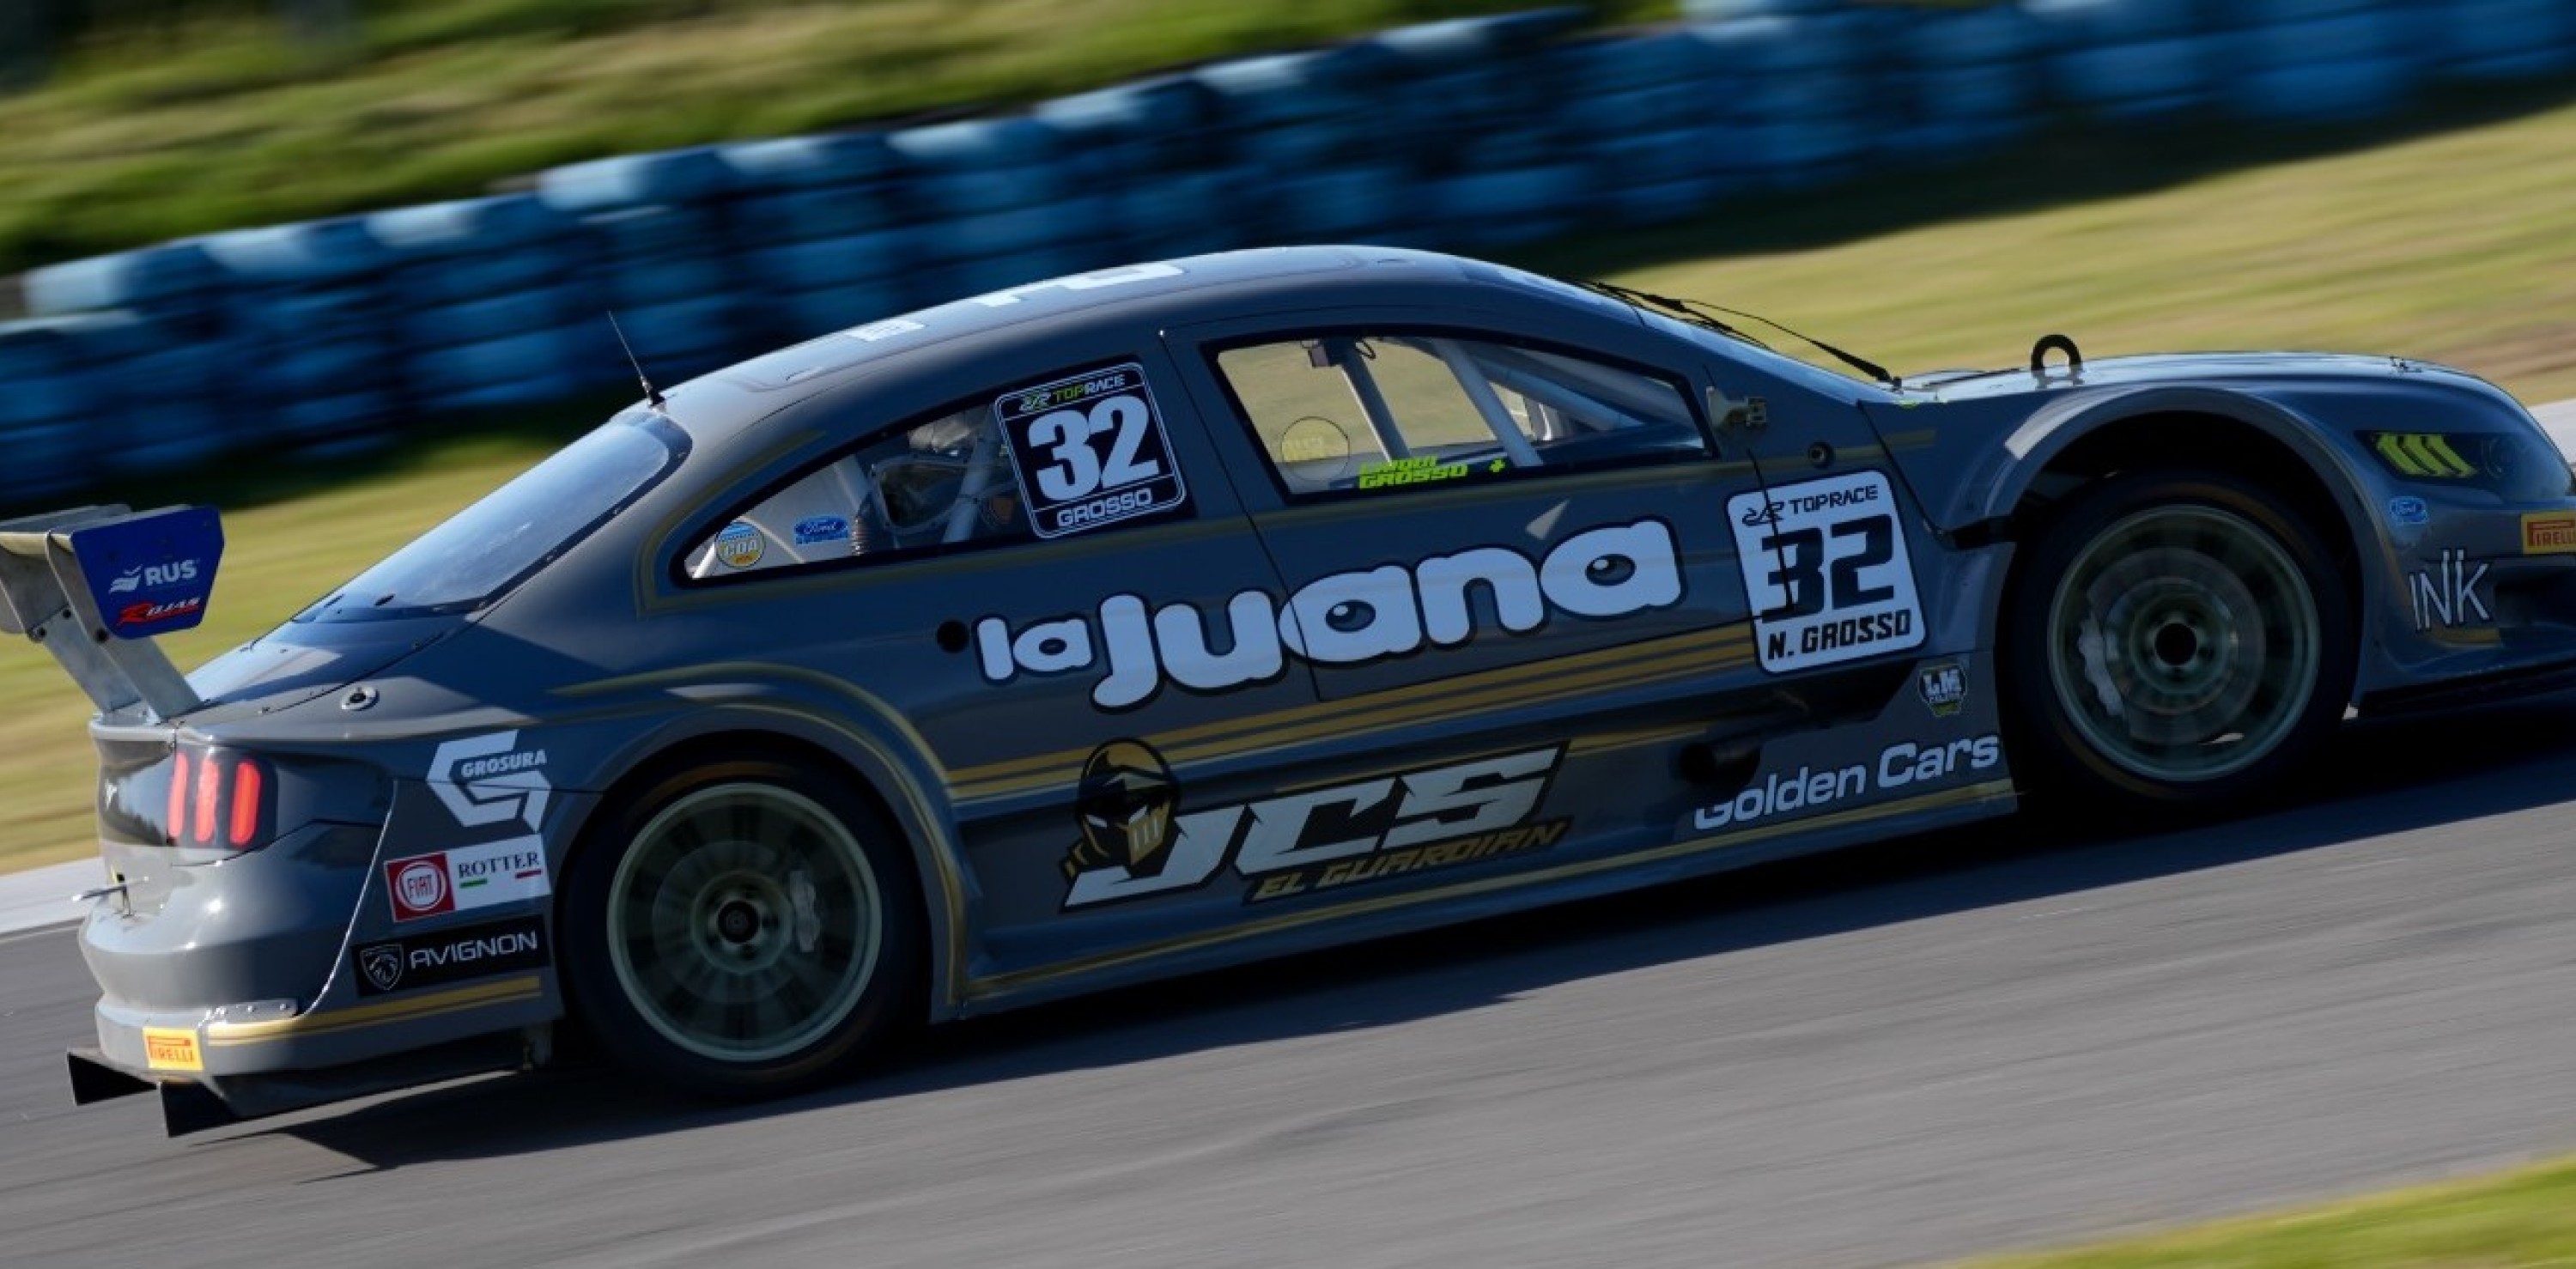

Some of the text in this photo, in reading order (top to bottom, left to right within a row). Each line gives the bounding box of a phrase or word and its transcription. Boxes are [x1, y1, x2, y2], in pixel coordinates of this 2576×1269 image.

[1028, 394, 1159, 501] 32
[1057, 487, 1153, 526] GROSSO
[143, 559, 197, 586] RUS
[1761, 513, 1894, 624] 32
[1767, 609, 1911, 660] N. GROSSO
[460, 749, 548, 778] GROSURA
[1693, 734, 2000, 829] Golden Cars
[1061, 744, 1566, 908] JCS
[458, 850, 541, 880] ROTTER
[1250, 820, 1571, 902] EL GUARDIAN
[407, 874, 433, 900] FIAT
[409, 930, 538, 971] AVIGNON
